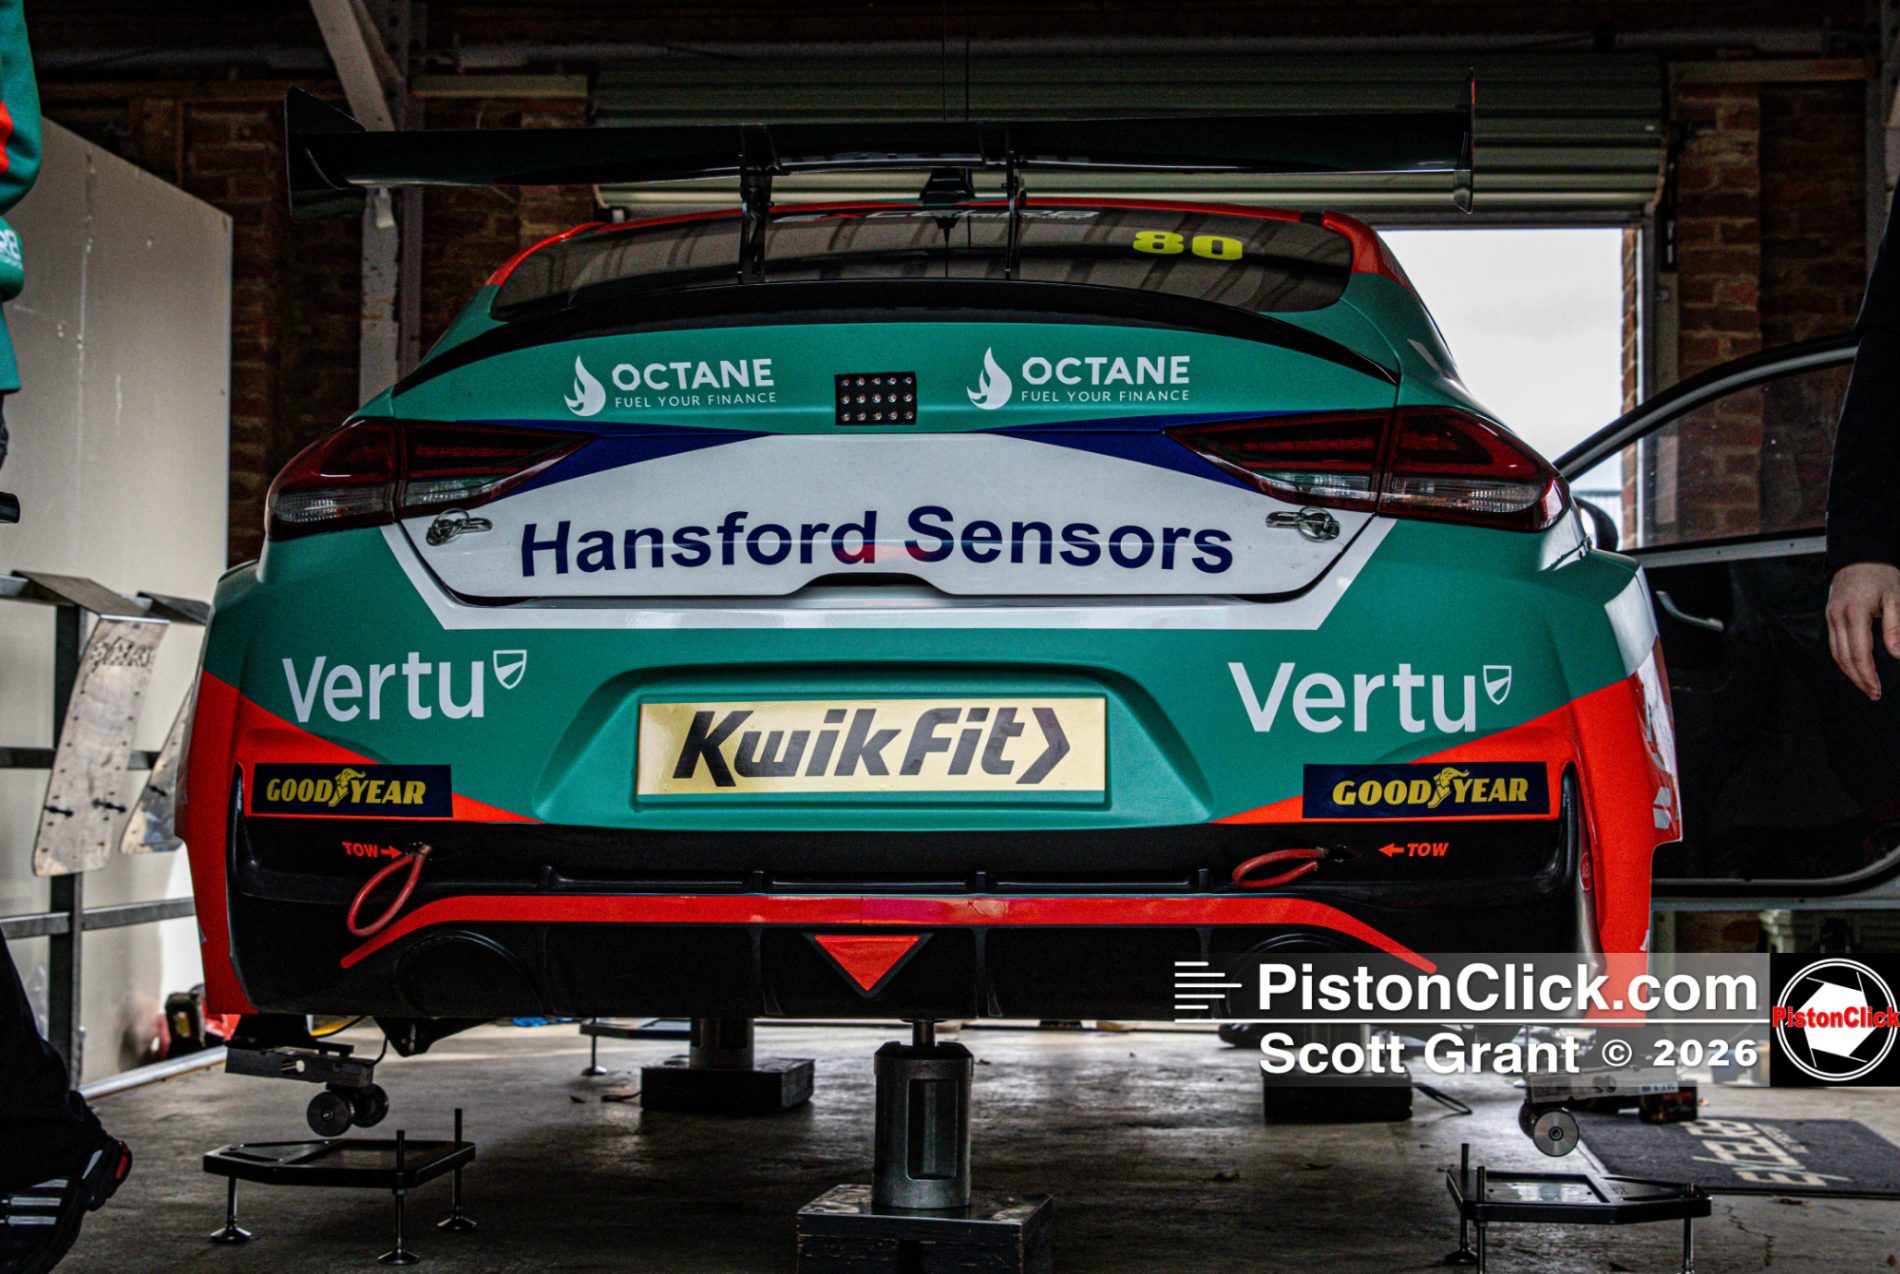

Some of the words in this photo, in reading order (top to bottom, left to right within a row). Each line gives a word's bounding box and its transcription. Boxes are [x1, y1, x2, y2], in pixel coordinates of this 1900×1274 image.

[1133, 230, 1243, 260] 80
[612, 358, 775, 391] OCTANE
[1022, 355, 1191, 385] OCTANE
[615, 397, 651, 408] FUEL
[658, 395, 701, 407] YOUR
[708, 392, 777, 405] FINANCE
[1021, 390, 1059, 402] FUEL
[1067, 390, 1111, 402] YOUR
[1120, 389, 1190, 402] FINANCE
[520, 510, 878, 577] Hansford
[905, 505, 1234, 574] Sensors
[282, 652, 485, 723] Vertu
[1227, 662, 1477, 733] Vertu
[266, 776, 427, 806] GOODYEAR
[1332, 776, 1529, 806] GOODYEAR
[342, 841, 379, 858] TOW
[1407, 842, 1449, 857] TOW
